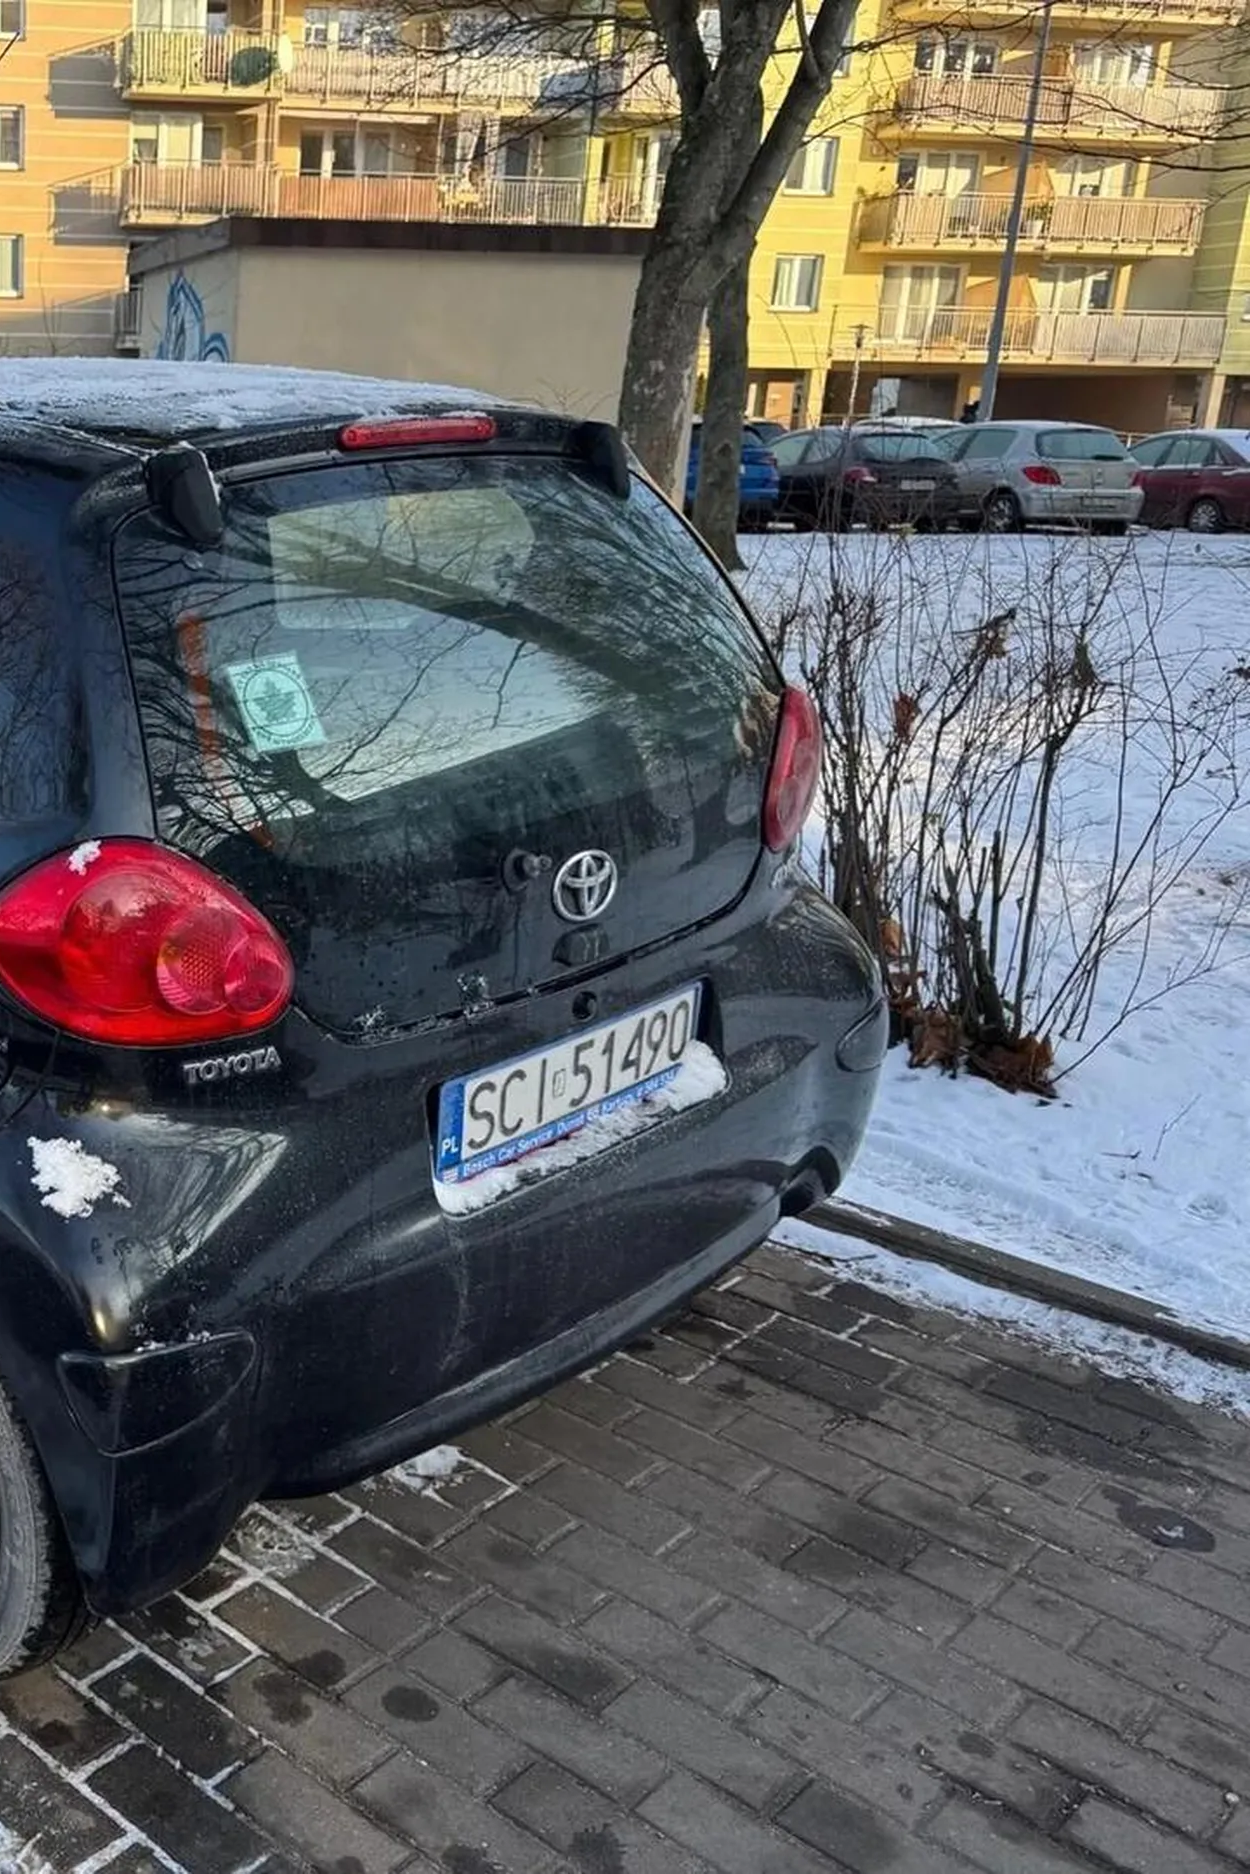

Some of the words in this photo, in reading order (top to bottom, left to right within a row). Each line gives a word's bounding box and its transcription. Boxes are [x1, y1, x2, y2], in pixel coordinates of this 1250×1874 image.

[183, 1046, 282, 1084] TOYOTA
[467, 1058, 548, 1150] SCI
[569, 1000, 691, 1108] 51490
[441, 1135, 460, 1158] PL
